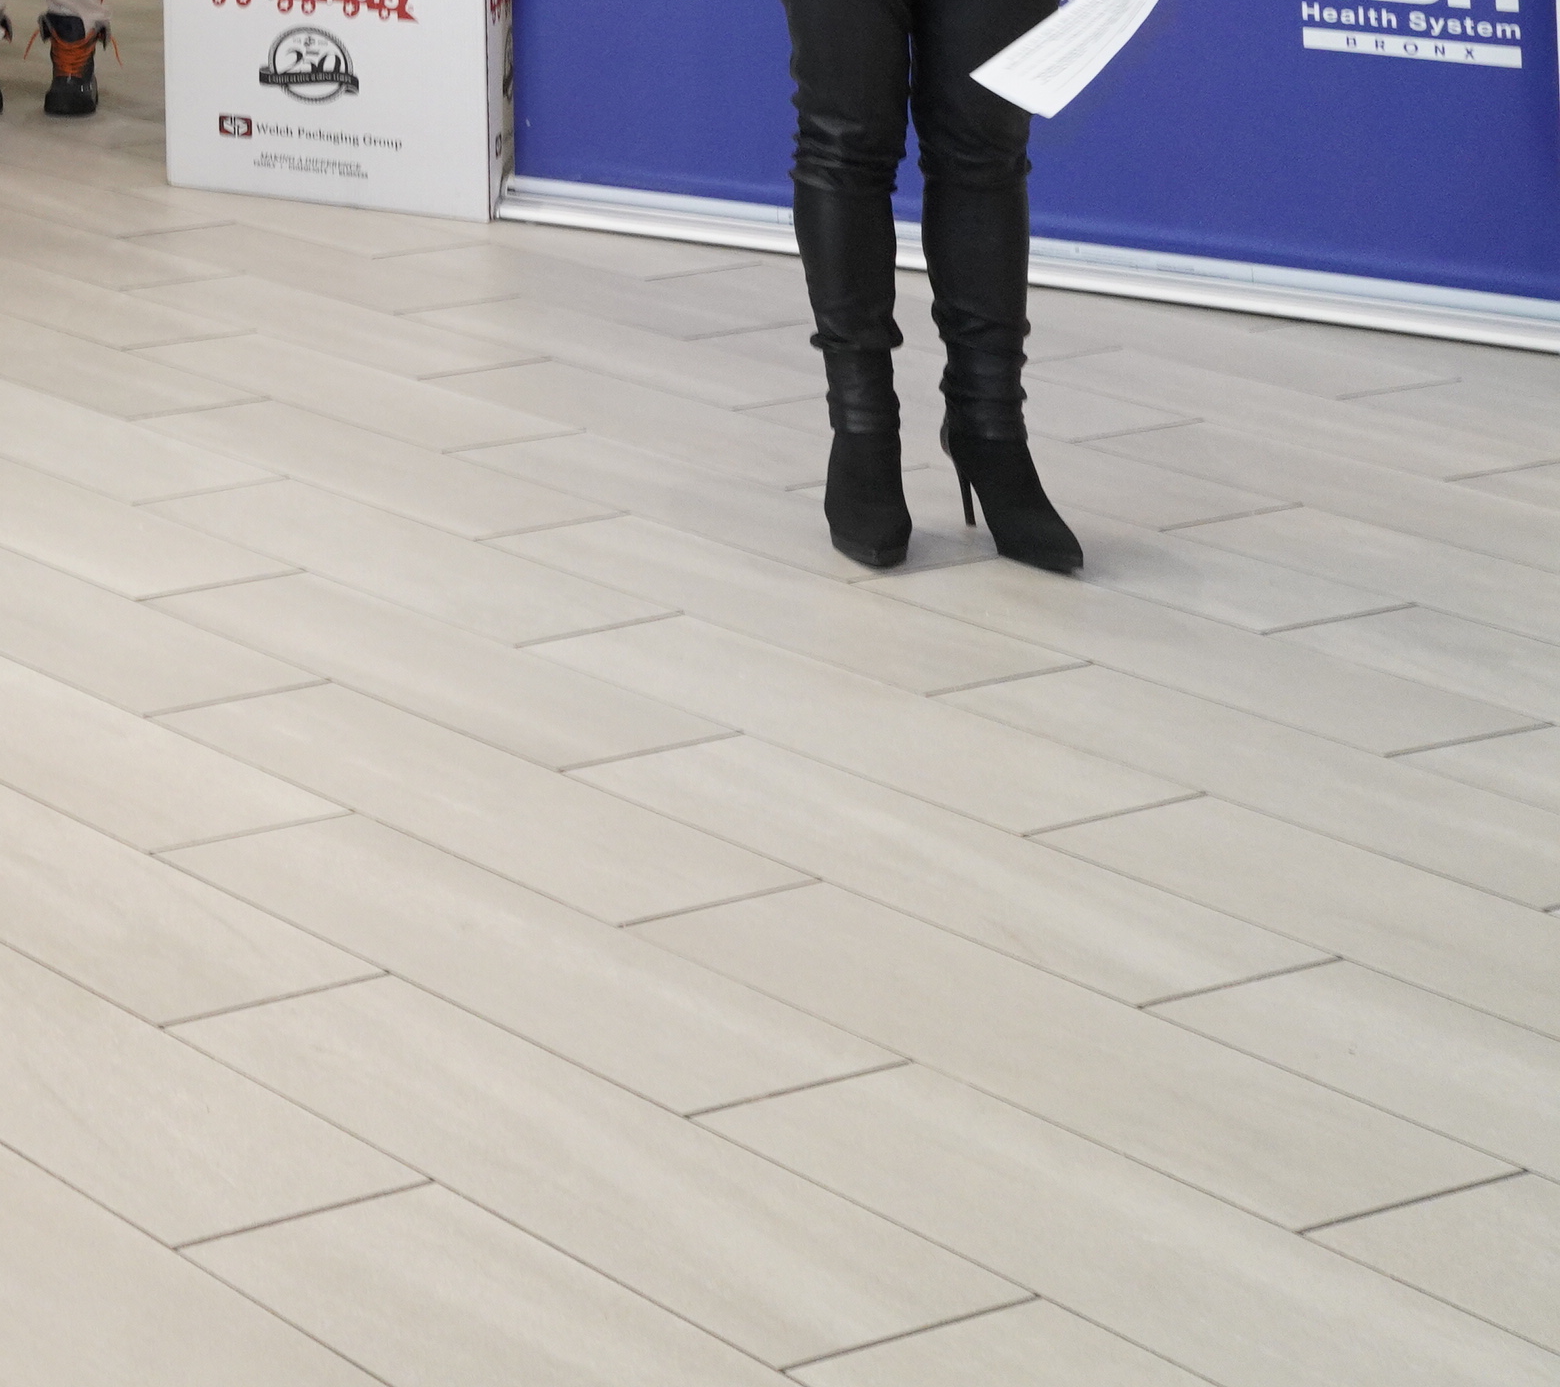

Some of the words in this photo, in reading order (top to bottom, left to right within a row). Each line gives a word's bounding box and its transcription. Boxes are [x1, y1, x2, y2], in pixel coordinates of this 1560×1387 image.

[1302, 2, 1396, 28] Health
[1410, 11, 1520, 39] System
[1344, 34, 1477, 60] BRONX
[256, 122, 294, 138] Welch
[297, 125, 360, 148] Packaging
[362, 133, 403, 152] Group
